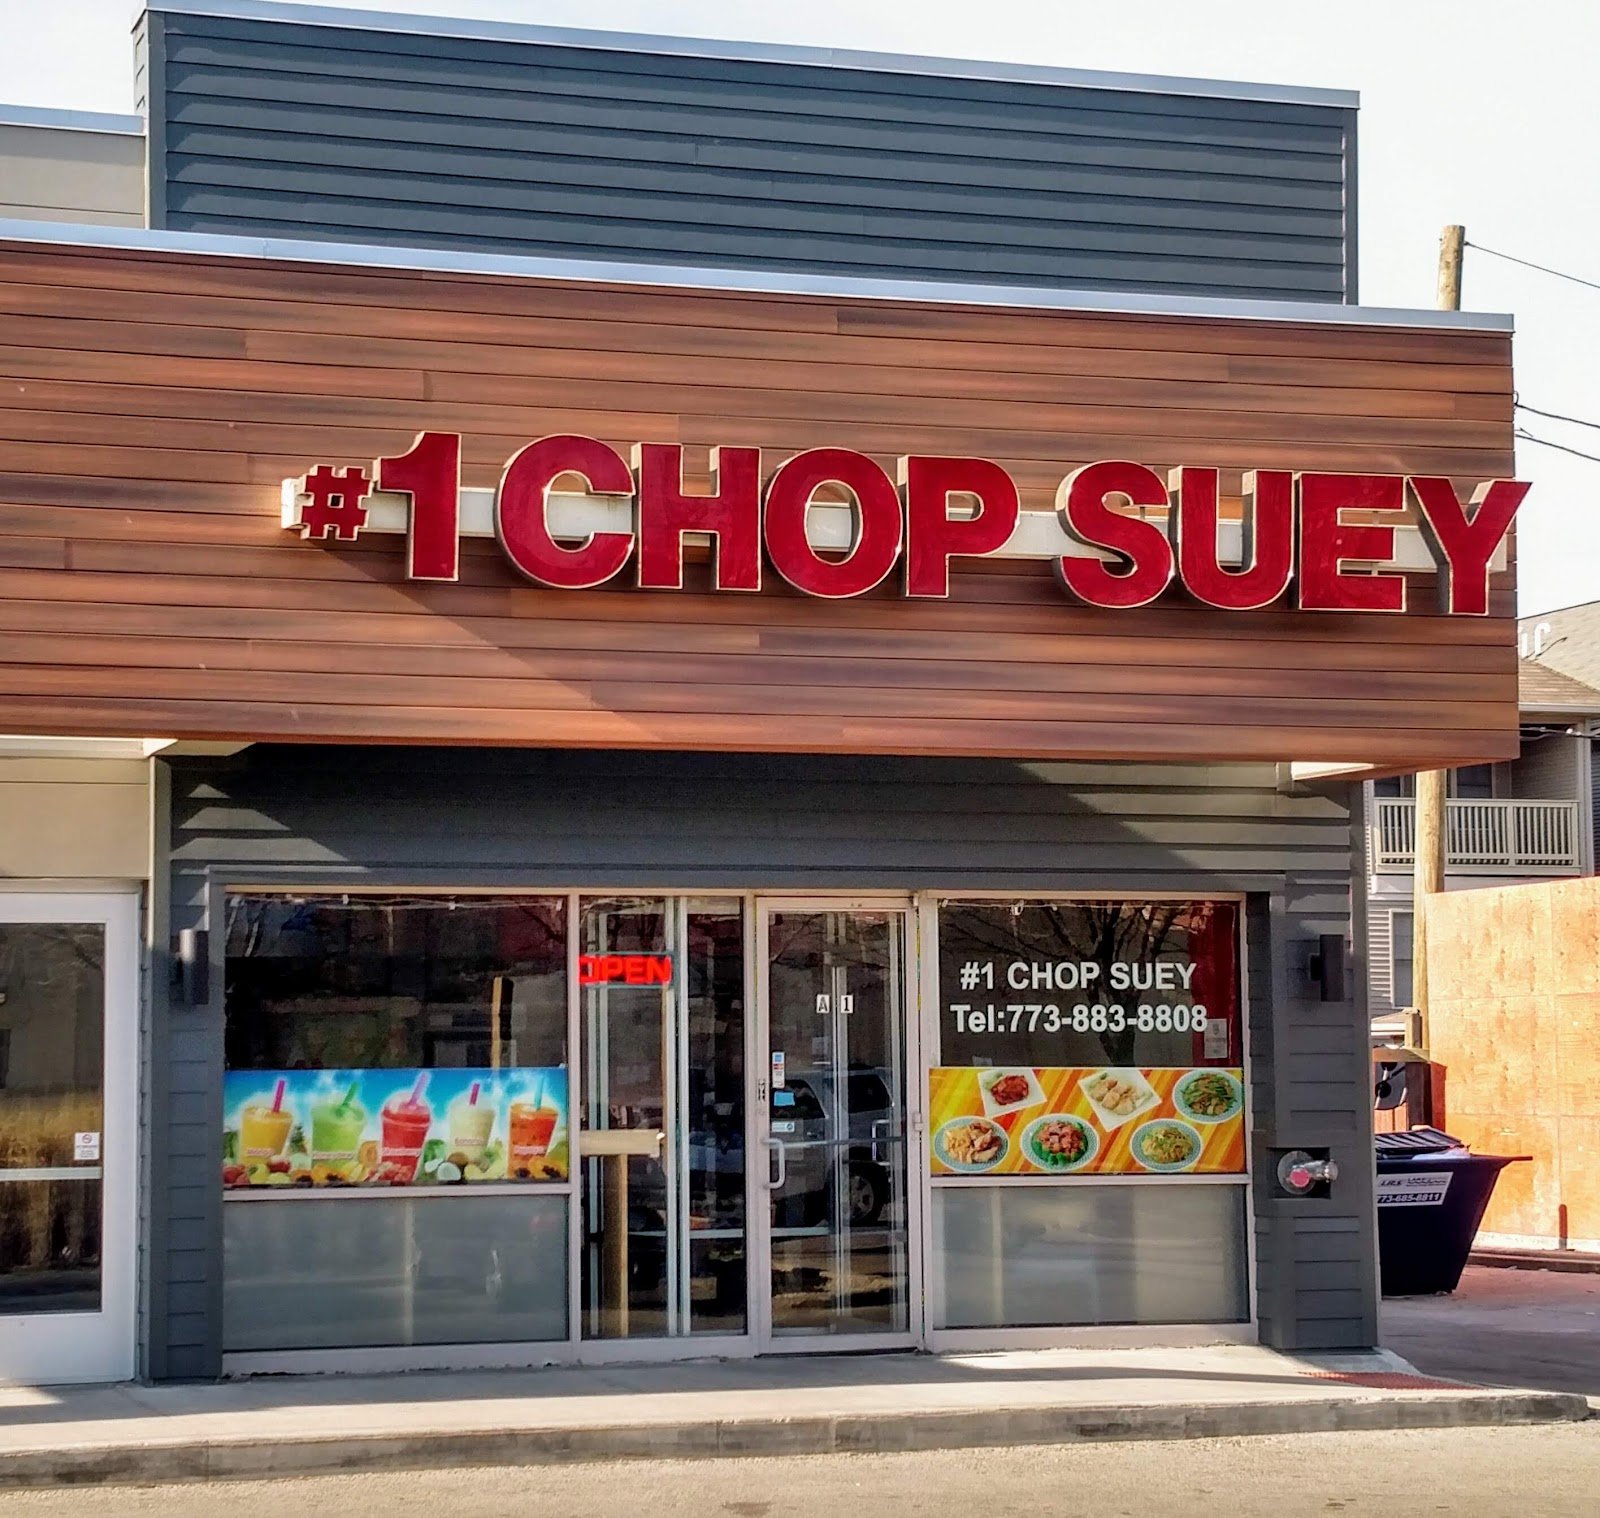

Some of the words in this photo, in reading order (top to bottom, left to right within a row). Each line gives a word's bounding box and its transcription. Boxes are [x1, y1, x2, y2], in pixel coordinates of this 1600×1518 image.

[301, 431, 462, 582] #1
[496, 433, 1020, 599] CHOP
[1057, 460, 1533, 616] SUEY
[578, 954, 672, 985] OPEN
[960, 962, 995, 990] #1
[1007, 962, 1100, 990] CHOP
[1110, 962, 1197, 990] SUEY
[950, 1004, 1208, 1033] Tel:773-883-8808
